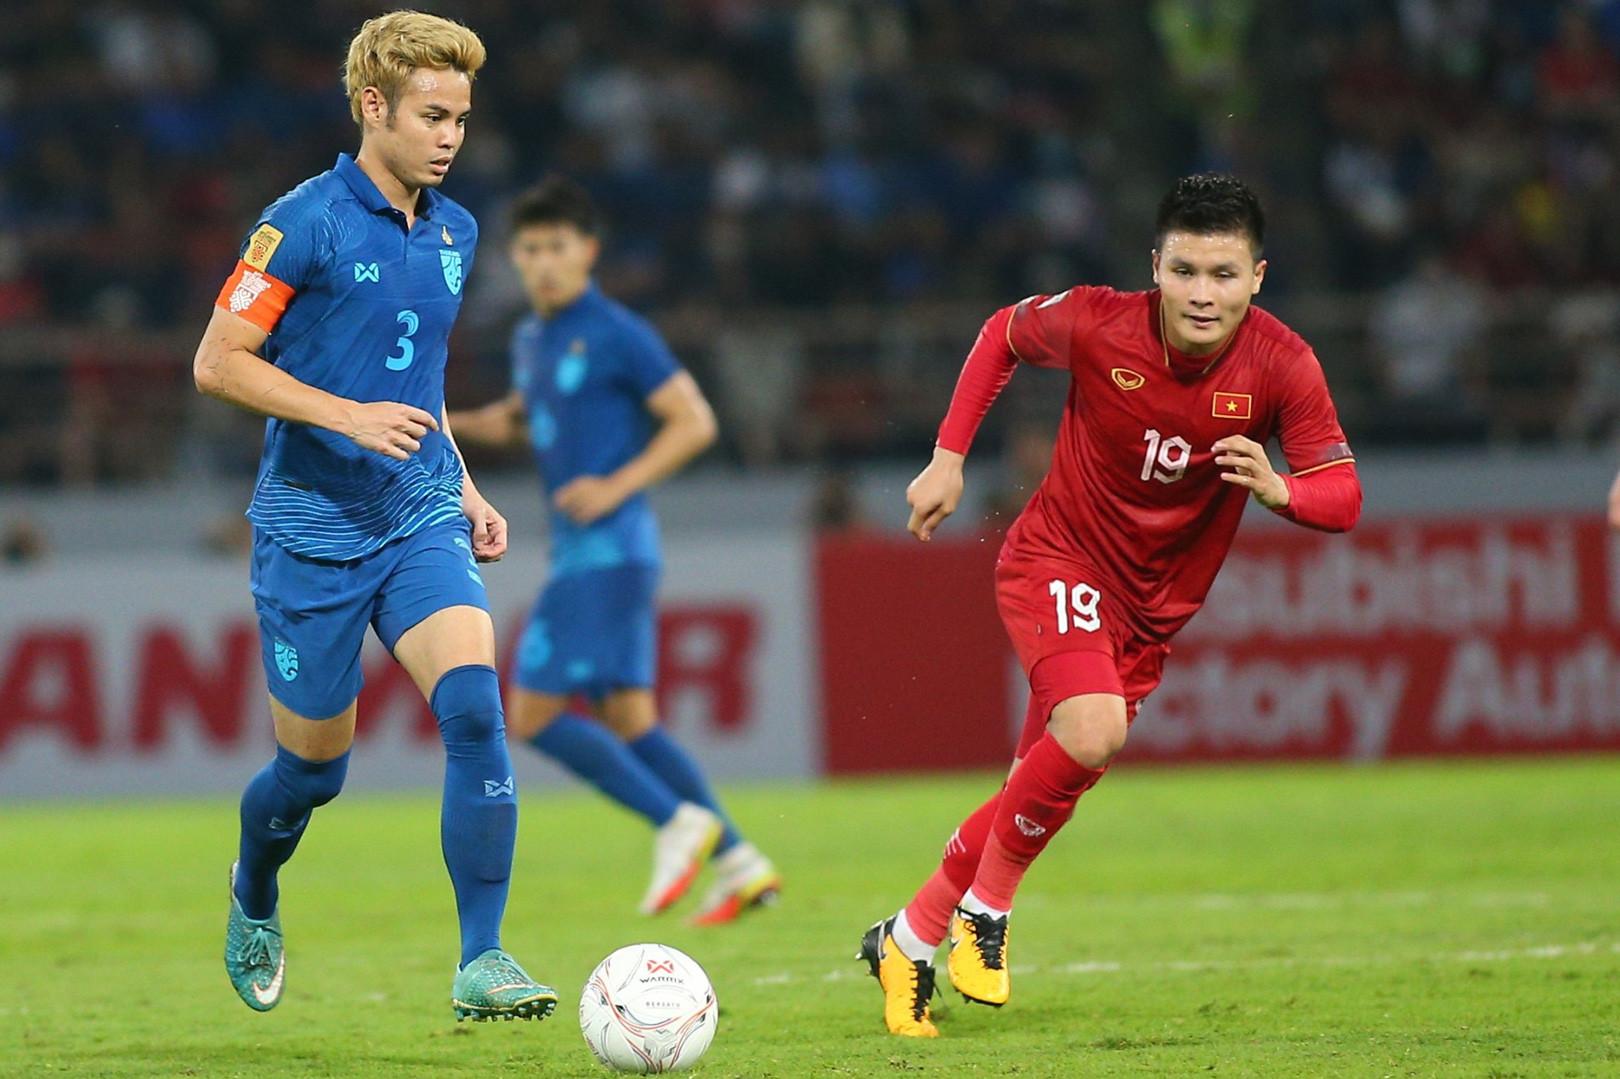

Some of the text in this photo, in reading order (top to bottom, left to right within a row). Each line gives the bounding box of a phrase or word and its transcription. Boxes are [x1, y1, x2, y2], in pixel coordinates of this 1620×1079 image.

[385, 309, 419, 371] 3
[1140, 429, 1192, 484] 19
[1049, 579, 1101, 634] 19
[1192, 519, 1577, 637] subishi
[0, 605, 762, 758] ANR
[1008, 636, 1620, 765] ctory Aut
[639, 976, 684, 985] WARRIX
